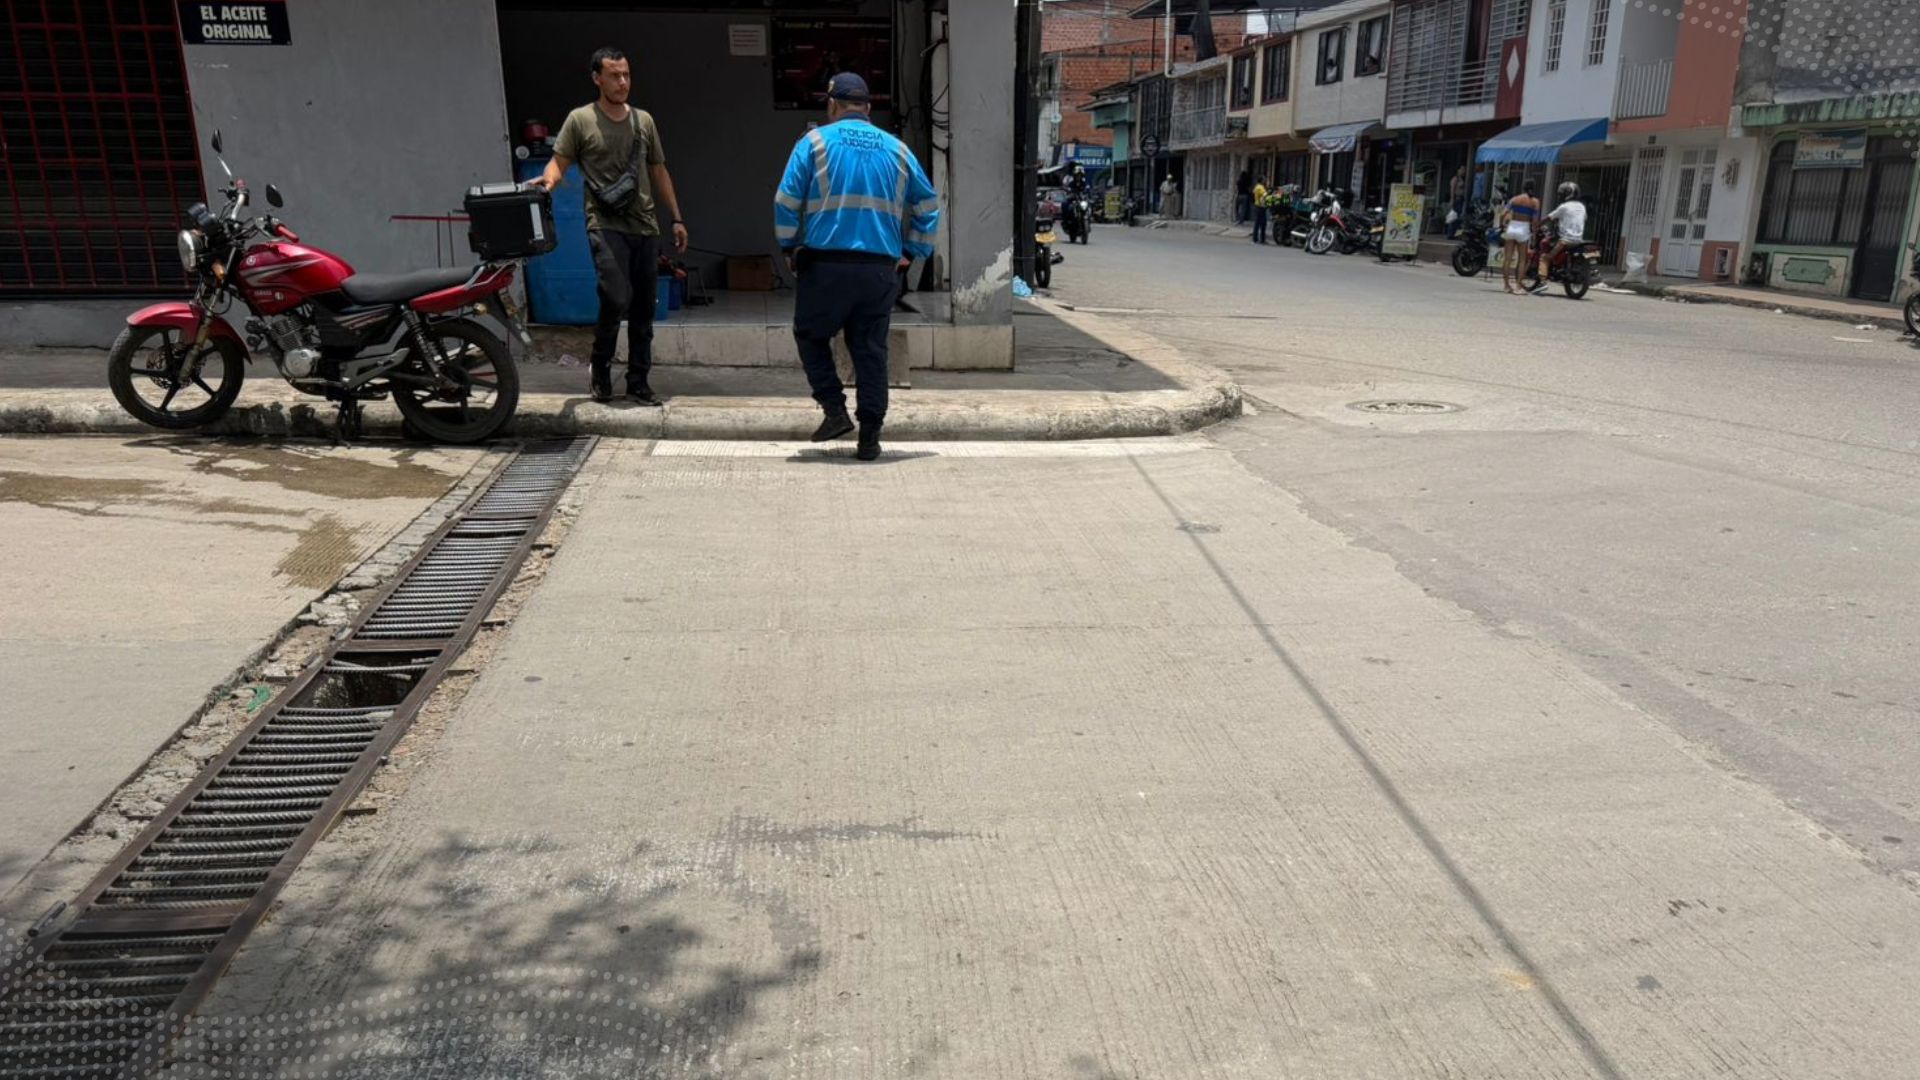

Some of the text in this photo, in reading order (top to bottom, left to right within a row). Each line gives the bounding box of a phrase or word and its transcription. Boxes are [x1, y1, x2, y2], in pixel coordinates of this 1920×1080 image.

[200, 5, 267, 21] EL ACEITE
[202, 23, 272, 39] ORIGINAL
[838, 127, 884, 142] POLICIA
[839, 136, 885, 150] JUDICIAL
